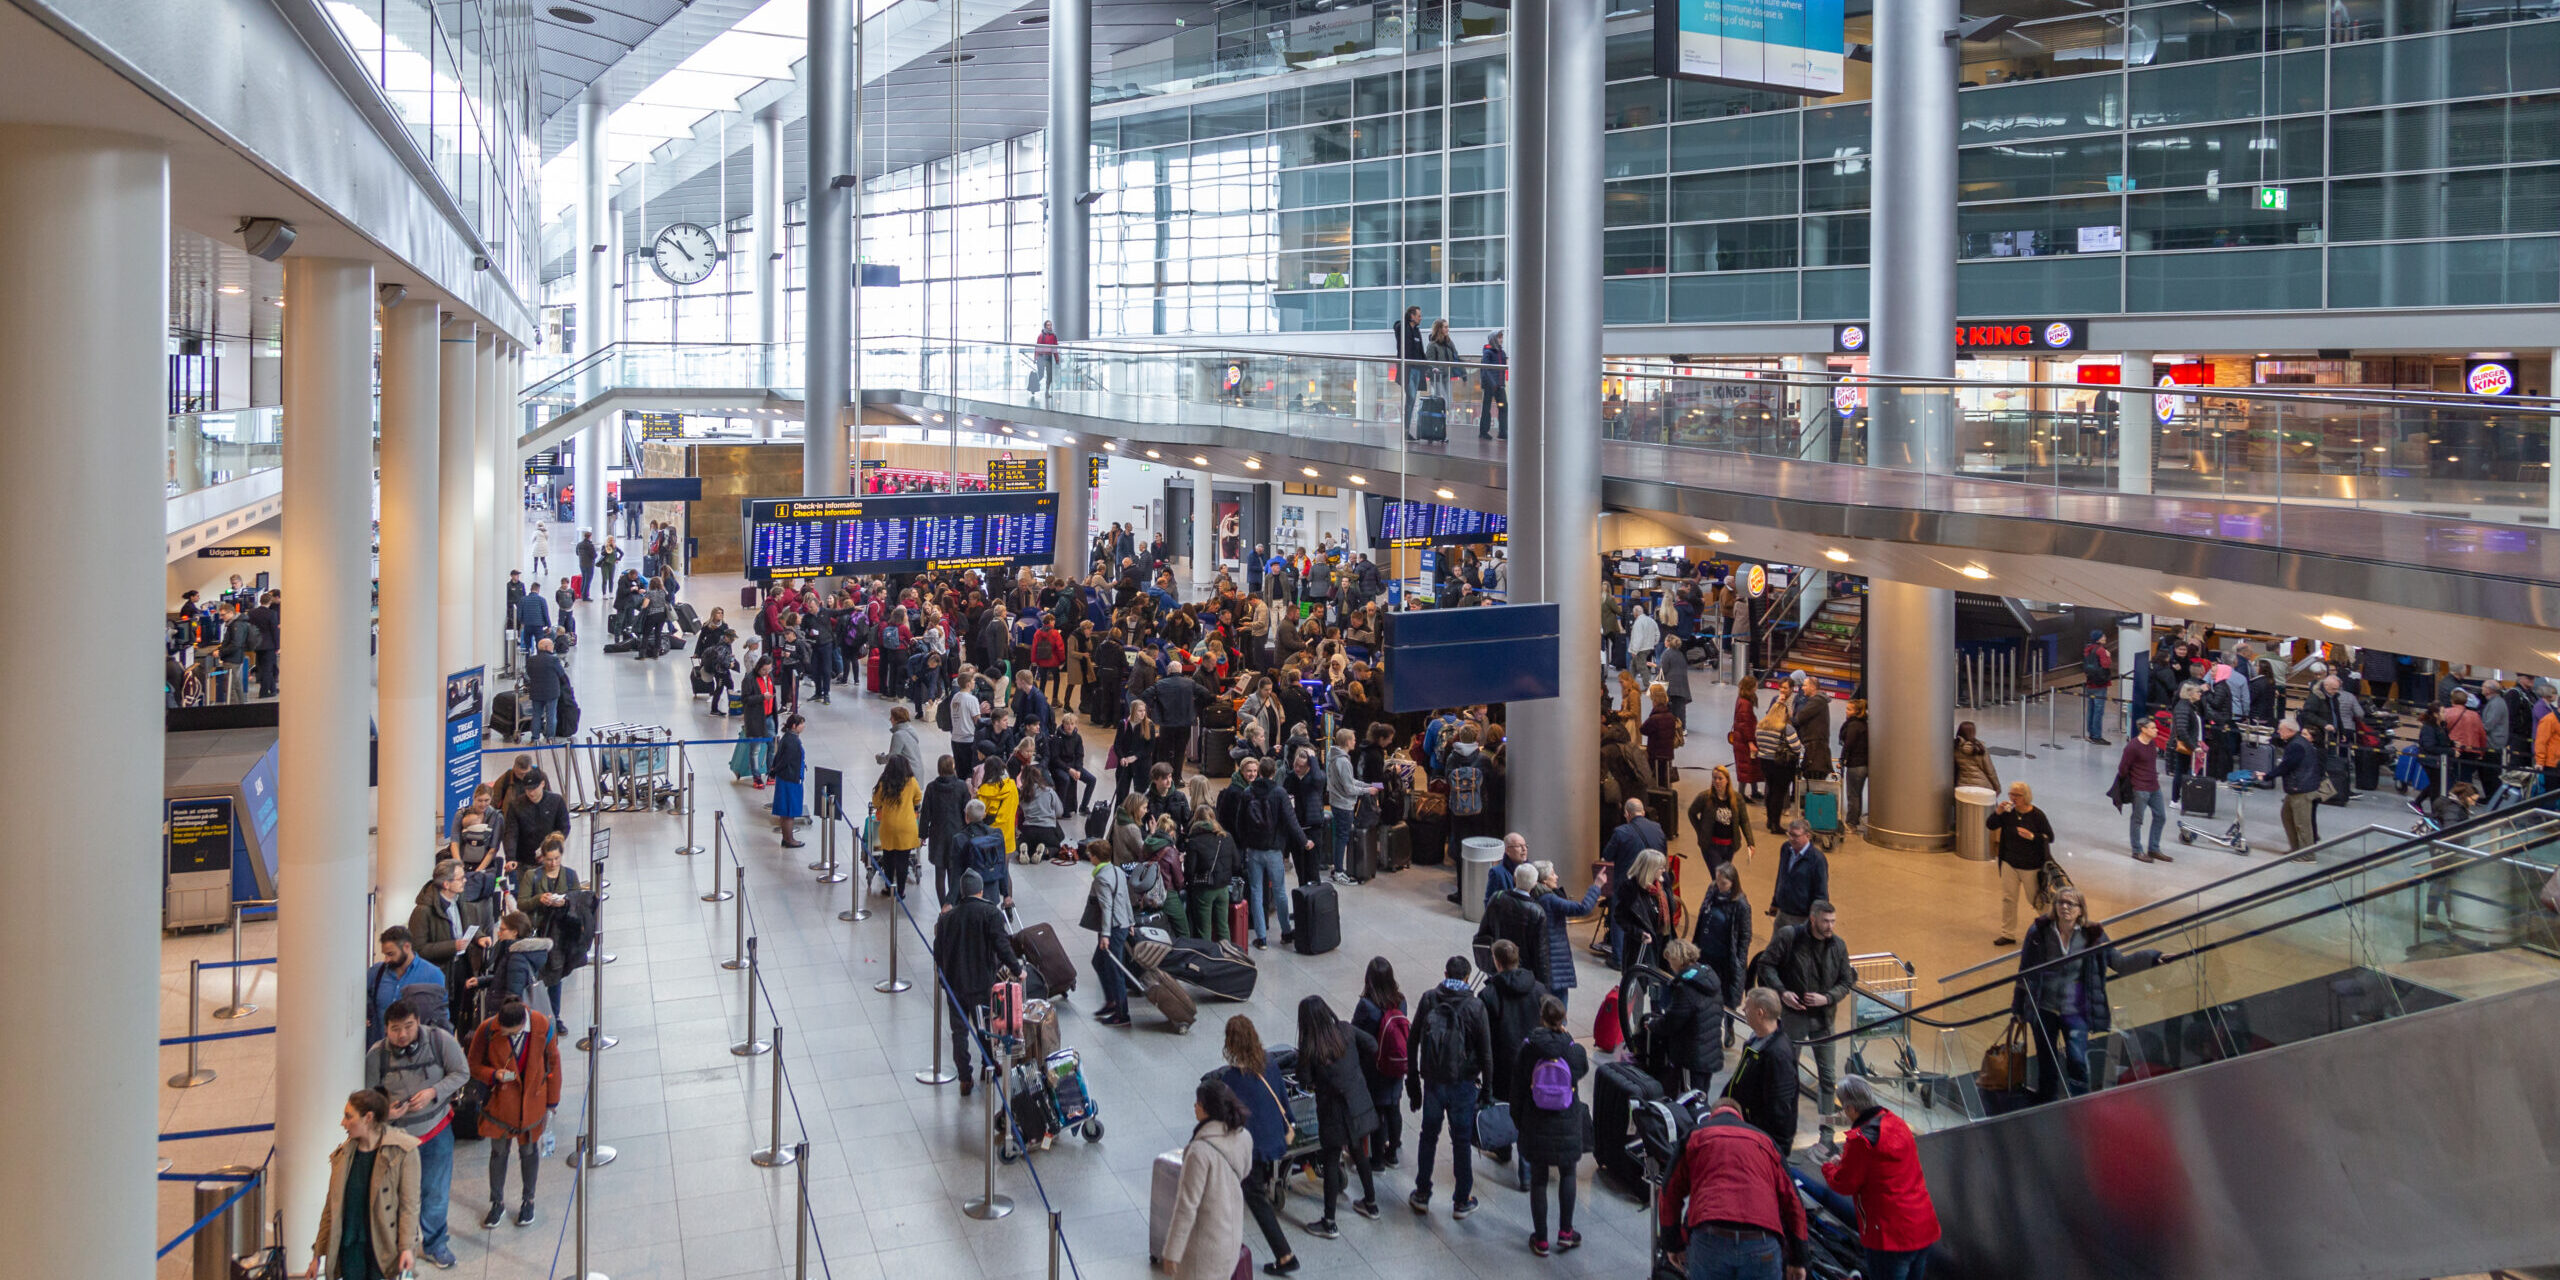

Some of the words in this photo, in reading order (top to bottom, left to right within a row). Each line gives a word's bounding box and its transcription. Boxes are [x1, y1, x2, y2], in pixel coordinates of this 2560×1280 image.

[1969, 326, 2031, 346] KING
[2049, 330, 2068, 342] KING
[2472, 370, 2505, 382] BURGER
[2474, 376, 2507, 391] KING
[1838, 390, 1855, 408] KING
[1426, 538, 1431, 546] 3
[826, 566, 833, 576] 3
[457, 720, 473, 732] TREAT
[452, 728, 479, 744] YOURSELF
